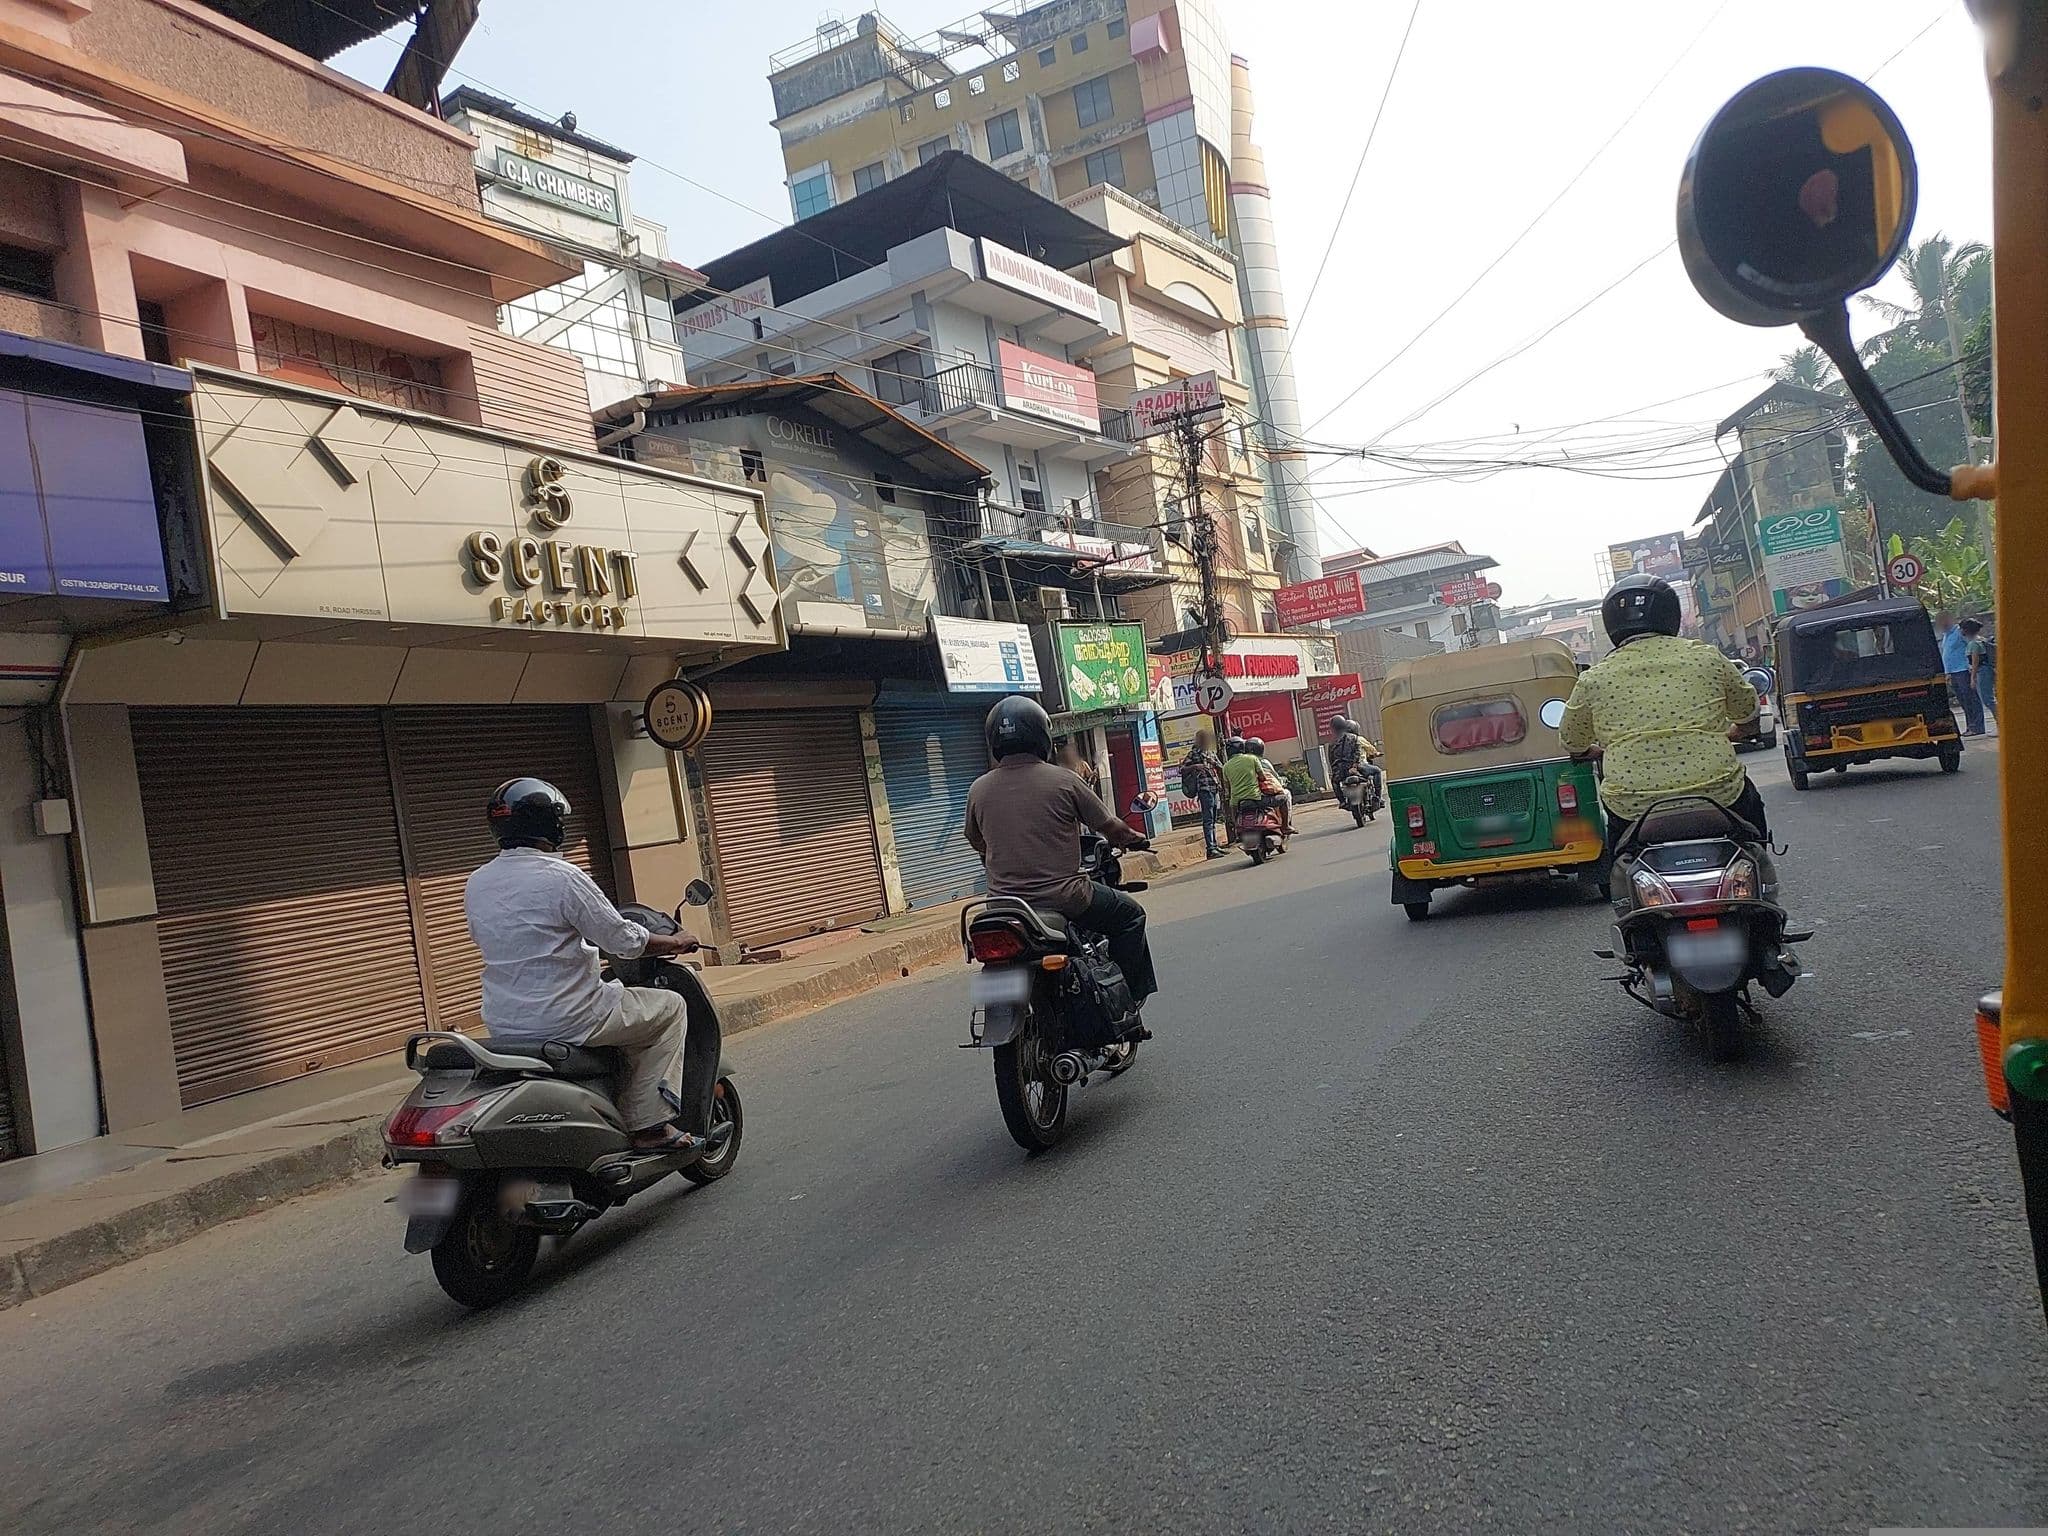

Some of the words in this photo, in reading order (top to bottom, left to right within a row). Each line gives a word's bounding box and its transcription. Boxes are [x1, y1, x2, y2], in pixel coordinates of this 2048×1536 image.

[536, 171, 613, 213] CHAMBERS
[989, 250, 1041, 288] ARADHANA
[1041, 272, 1073, 301] TOURIST
[1073, 287, 1098, 312] HOME
[681, 303, 729, 338] TOURIST
[1023, 400, 1051, 414] ARADHANA
[767, 416, 835, 449] CORELLE
[469, 531, 639, 600] SCENT
[1713, 551, 1743, 565] Kala
[1894, 562, 1916, 580] 30
[1307, 583, 1329, 601] BEER
[1334, 577, 1356, 595] WINE
[1452, 581, 1475, 590] HOTEL
[333, 606, 350, 614] ROAD
[494, 597, 629, 629] FACTORY
[1244, 655, 1299, 678] FURNISHINGS
[1300, 684, 1358, 707] Seafort
[656, 713, 689, 727] SCENT
[1675, 857, 1708, 866] SUZUKI
